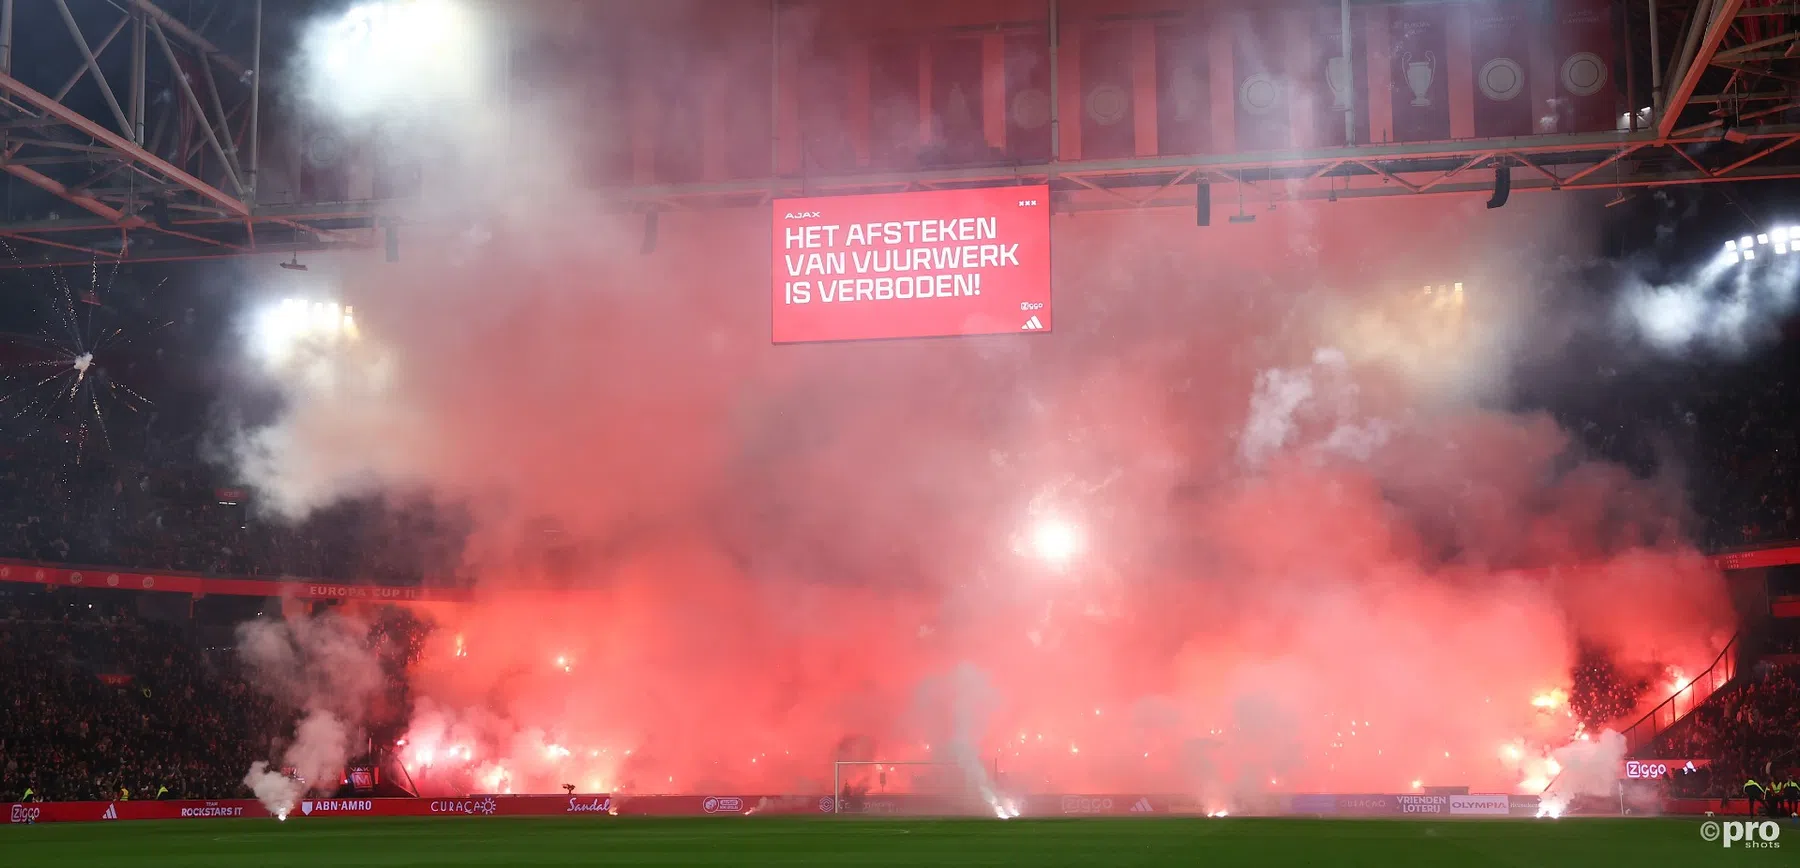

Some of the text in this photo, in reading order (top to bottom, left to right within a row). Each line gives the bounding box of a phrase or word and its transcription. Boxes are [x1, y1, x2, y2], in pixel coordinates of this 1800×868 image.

[785, 211, 820, 220] AJAX
[785, 216, 997, 249] HET AFSTEKEN
[785, 243, 1020, 277] VAN VUURWERK
[785, 273, 981, 305] IS VERBODEN!
[310, 585, 366, 597] EUROPA
[373, 588, 400, 598] CUP
[1396, 796, 1446, 805] VRIENDEN
[181, 807, 243, 817] ROCKSTARS IT
[1403, 804, 1440, 813] LOTERIJ
